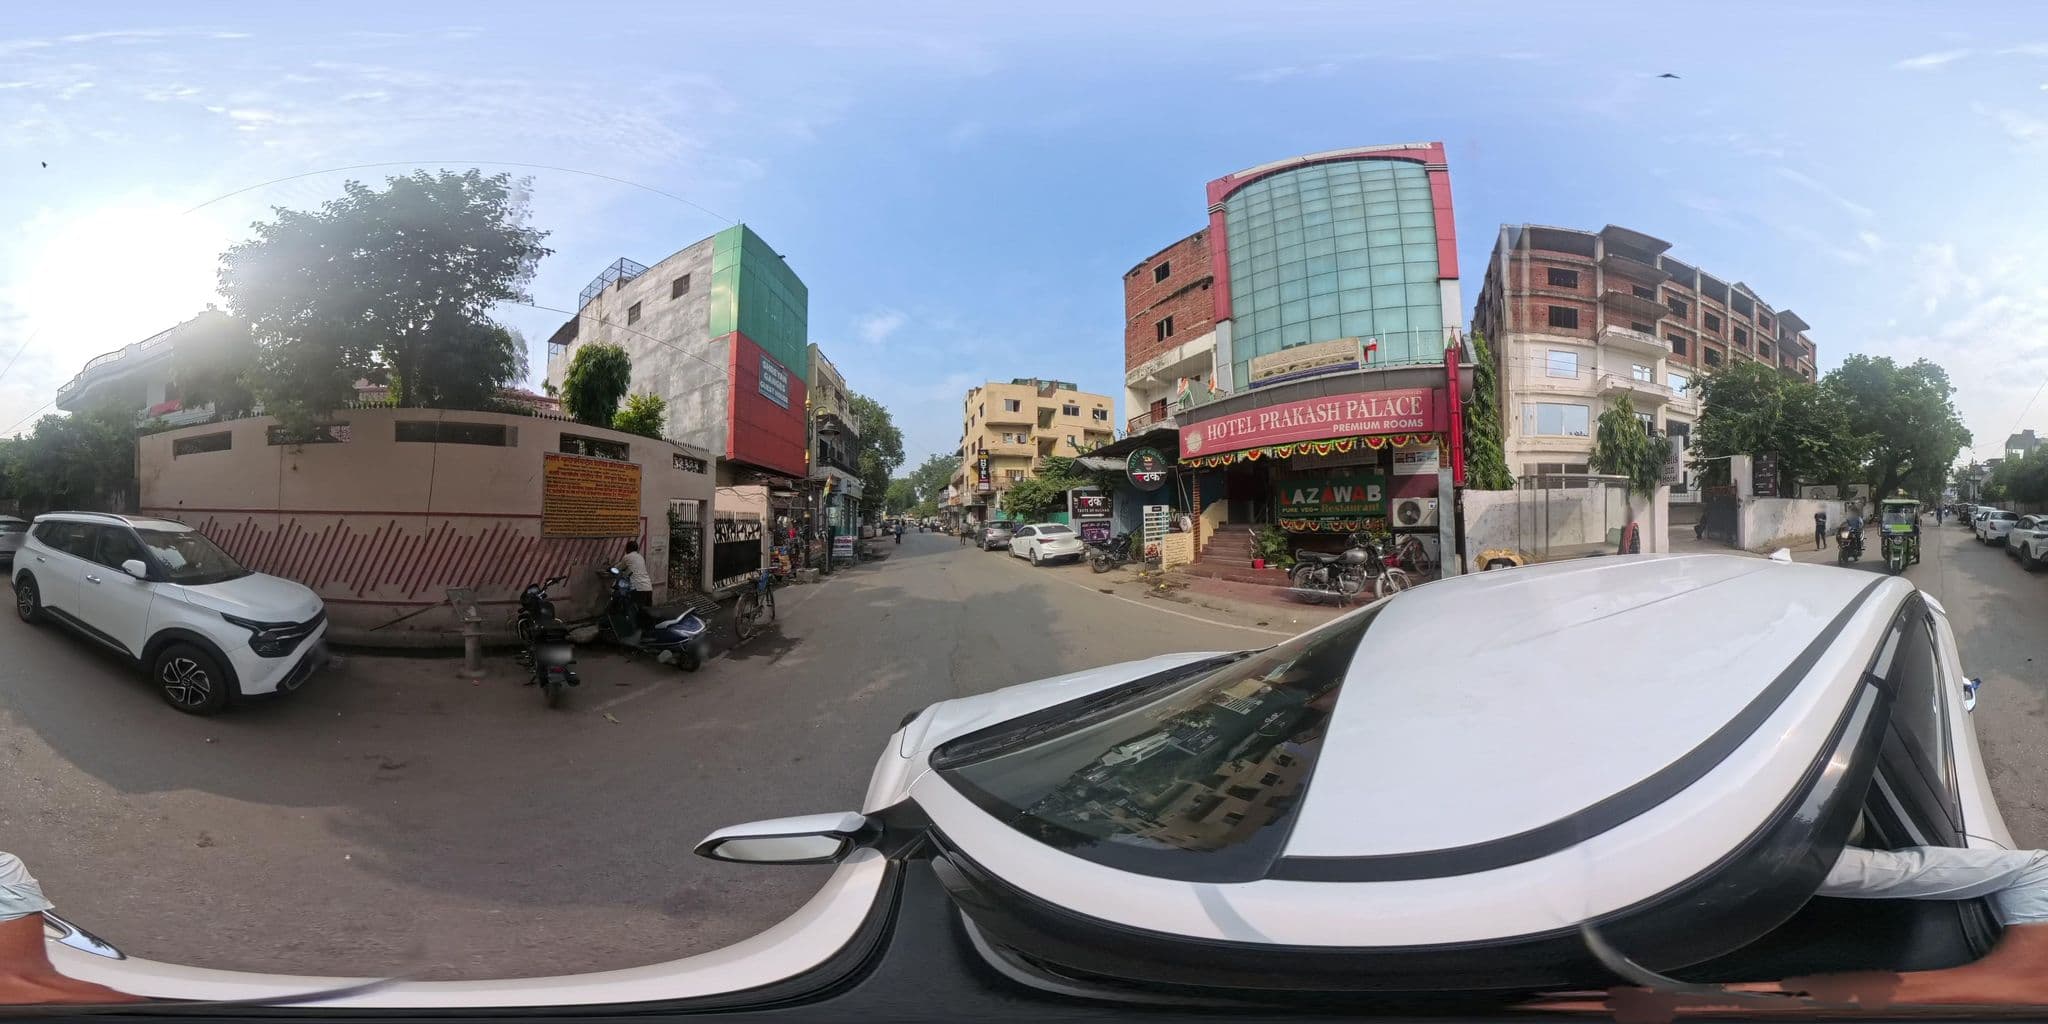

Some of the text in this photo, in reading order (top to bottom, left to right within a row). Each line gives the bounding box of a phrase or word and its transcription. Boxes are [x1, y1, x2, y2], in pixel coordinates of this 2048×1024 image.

[1208, 396, 1424, 440] HOTEL PRAKASH PALACE
[1333, 418, 1424, 432] PREMIUM ROOMS
[1280, 484, 1382, 507] LAZAWAB
[1321, 503, 1380, 513] Restaurant
